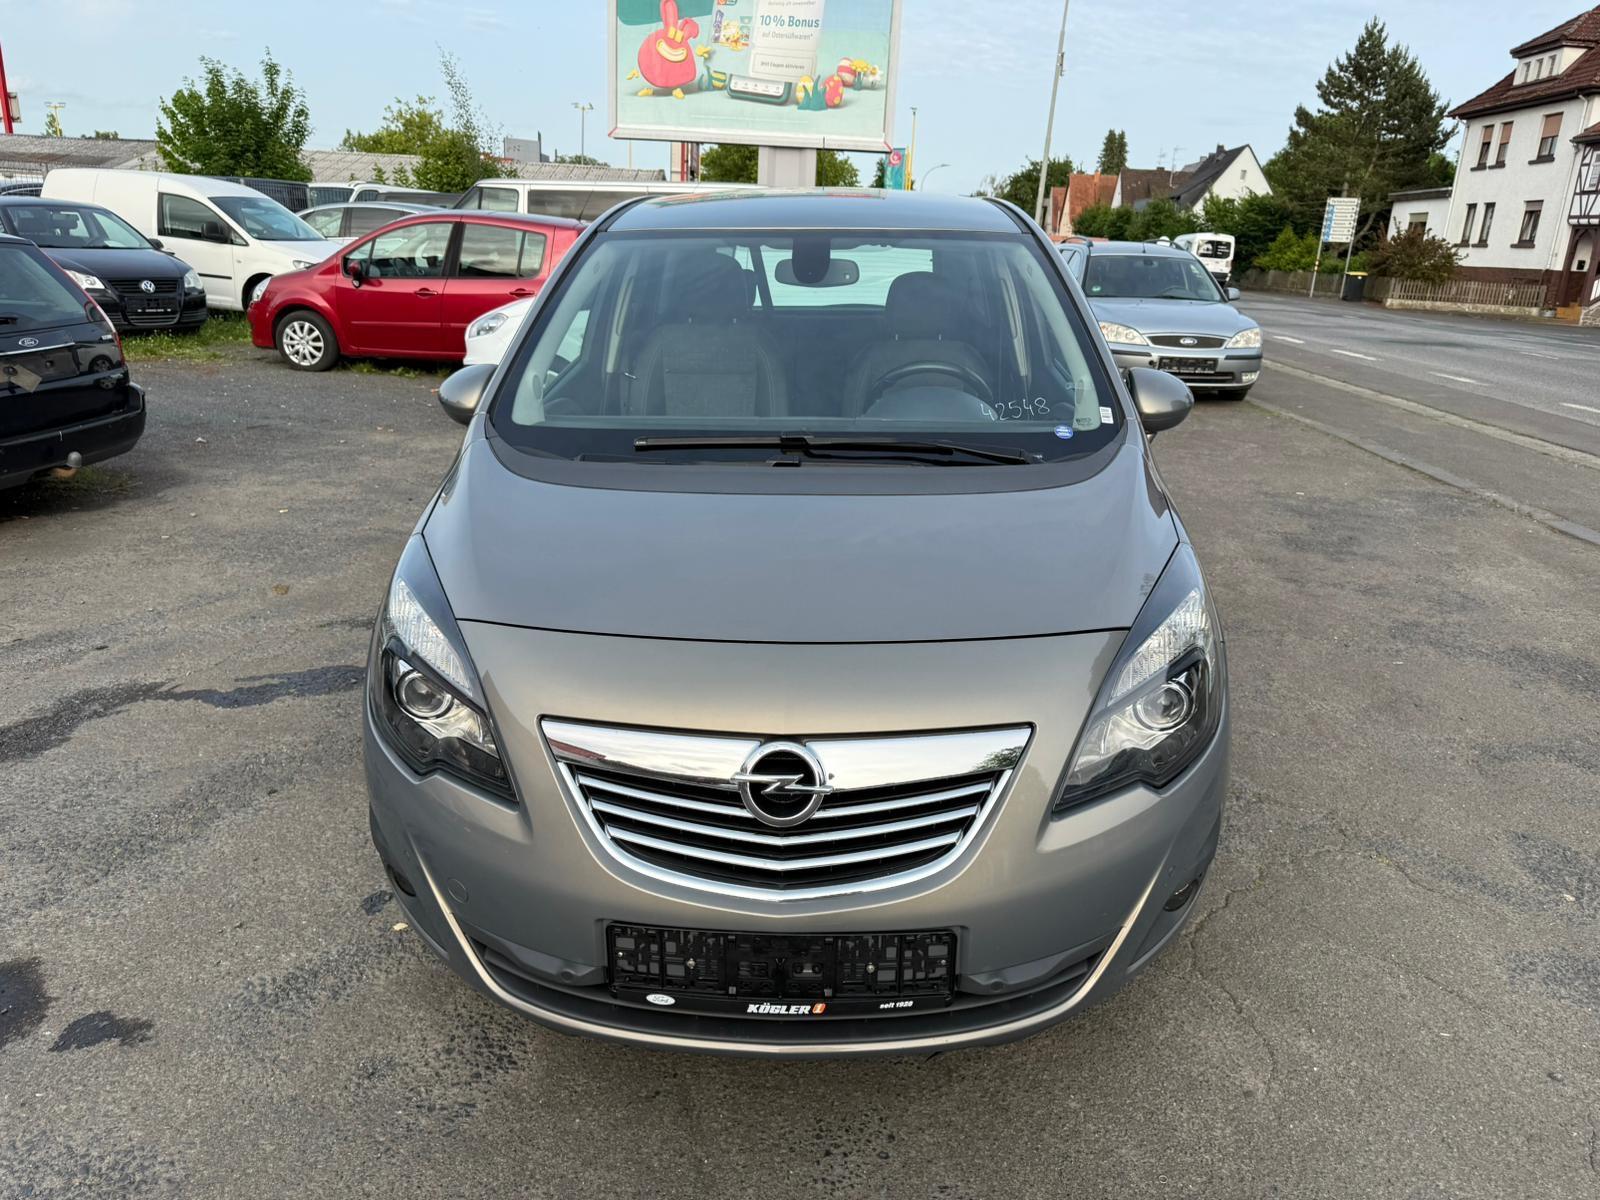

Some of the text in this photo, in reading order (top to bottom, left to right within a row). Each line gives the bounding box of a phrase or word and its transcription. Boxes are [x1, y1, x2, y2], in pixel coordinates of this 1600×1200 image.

[788, 16, 820, 28] Bonus
[980, 397, 1050, 421] 42548
[747, 1002, 811, 1014] KÖGLER
